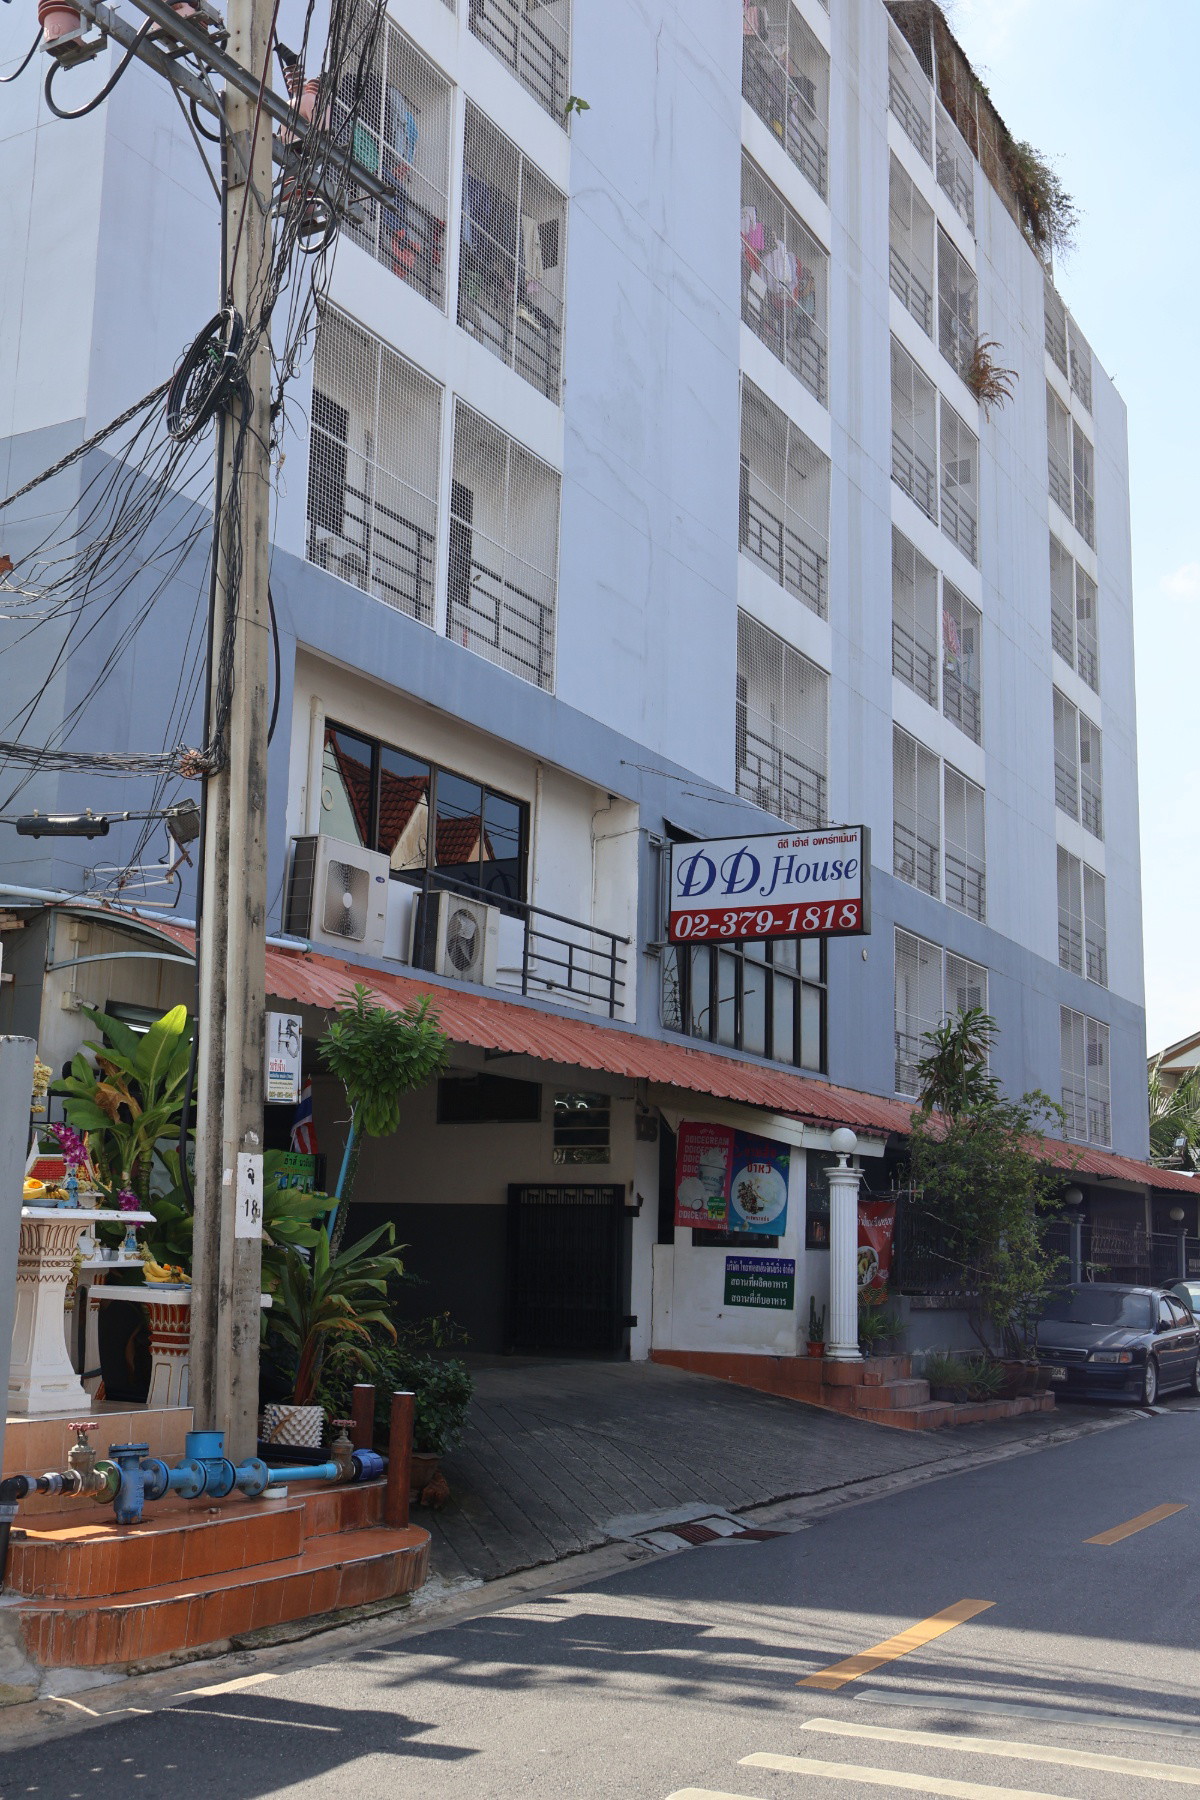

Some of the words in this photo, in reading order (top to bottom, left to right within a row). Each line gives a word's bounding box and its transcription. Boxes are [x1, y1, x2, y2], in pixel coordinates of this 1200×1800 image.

[677, 845, 761, 897] DD
[759, 854, 858, 897] House
[675, 903, 858, 938] 02-379-1818
[730, 1273, 788, 1289] สถานที่ผลิตอาหาร
[731, 1289, 787, 1306] สถานที่เก็บอาหาร
